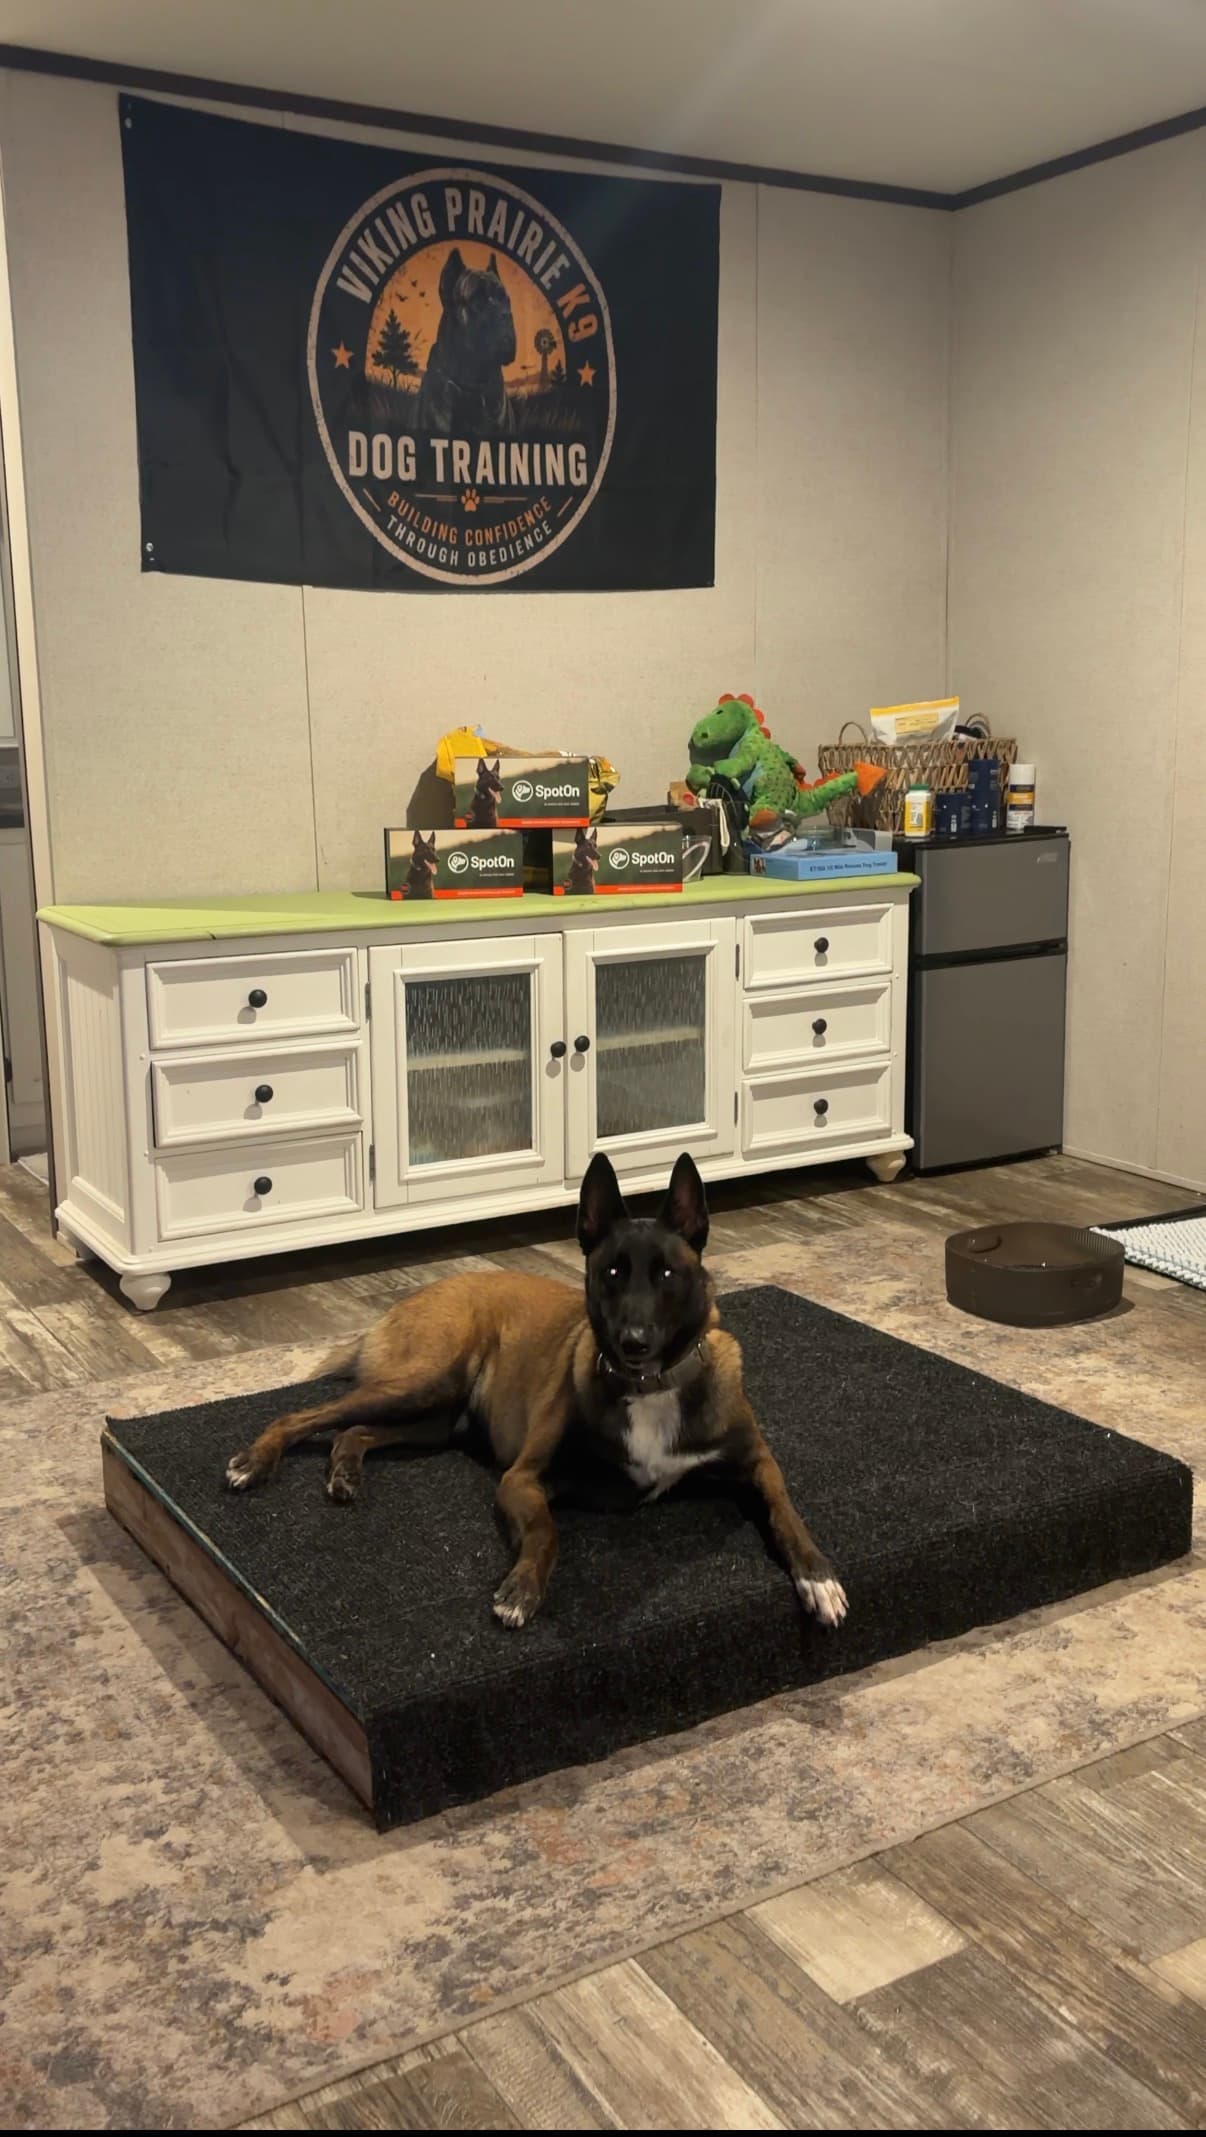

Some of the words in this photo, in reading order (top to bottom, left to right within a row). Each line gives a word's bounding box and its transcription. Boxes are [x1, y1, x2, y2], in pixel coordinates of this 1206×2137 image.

[336, 192, 437, 304] VIKING
[444, 187, 571, 290] PRAIRIE
[557, 282, 599, 343] K9
[348, 430, 417, 483] DOG
[430, 438, 588, 487] TRAINING
[386, 514, 459, 567] THROUGH
[467, 520, 553, 567] OBEDIENCE
[387, 490, 459, 545] BUILDING
[464, 496, 552, 547] CONFIDENCE
[535, 784, 580, 800] SpotOn
[470, 855, 514, 871] SpotOn
[631, 851, 675, 867] SpotOn
